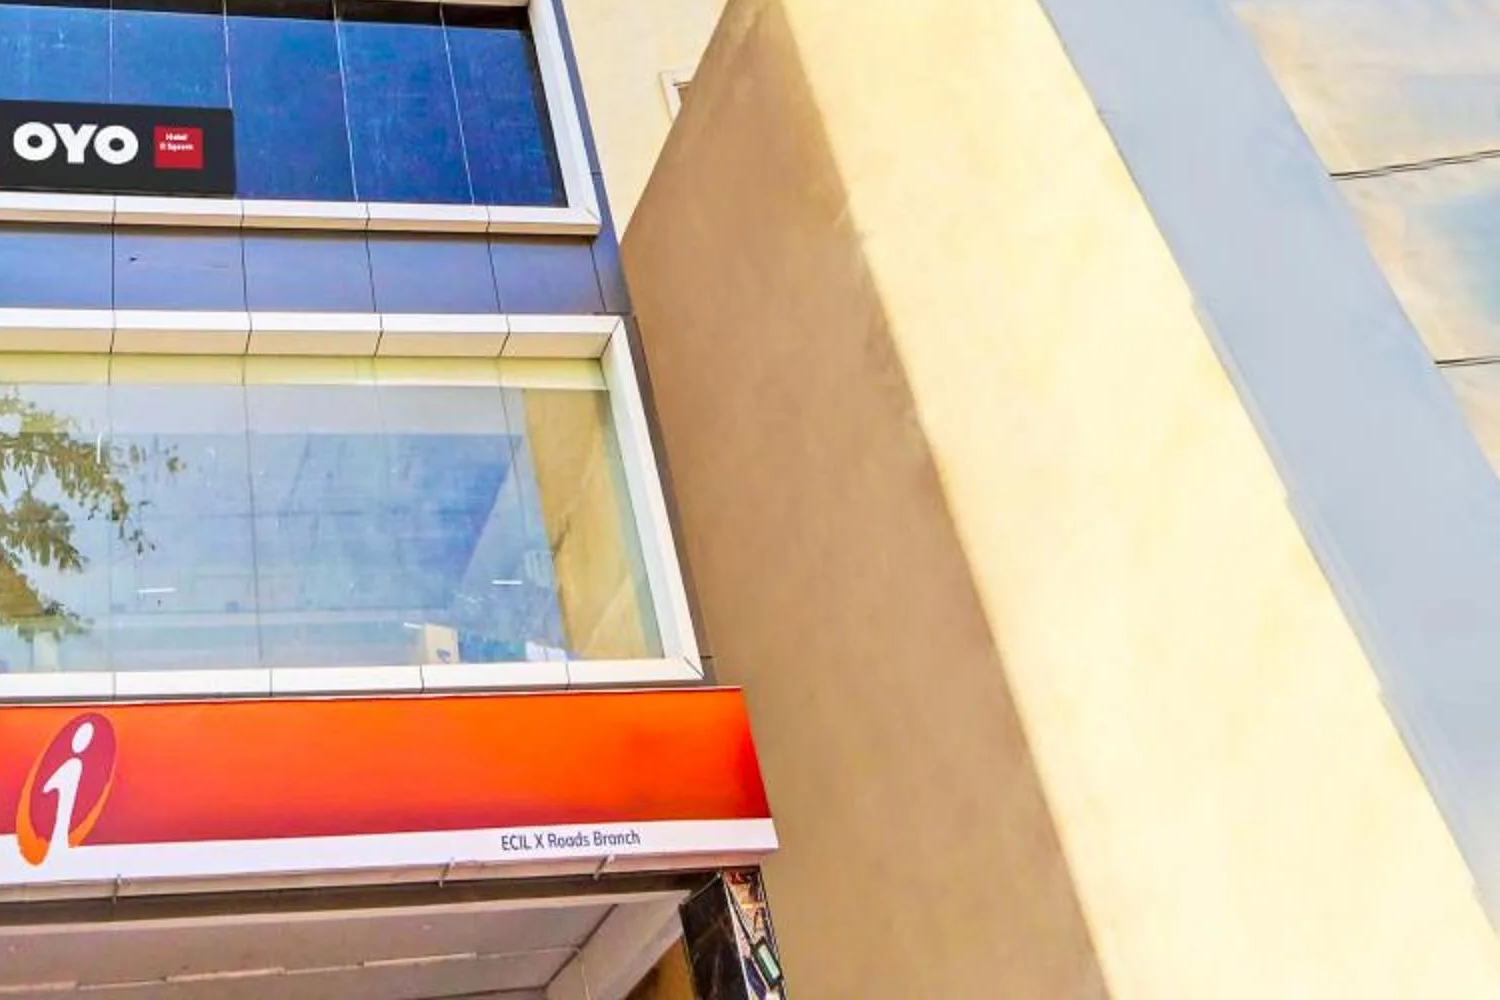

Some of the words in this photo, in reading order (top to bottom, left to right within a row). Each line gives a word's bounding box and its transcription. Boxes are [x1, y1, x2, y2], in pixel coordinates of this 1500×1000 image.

[12, 121, 139, 165] OYO
[501, 834, 532, 851] ECIL
[534, 833, 545, 849] X
[548, 830, 590, 849] Roads
[593, 829, 641, 847] Branch
